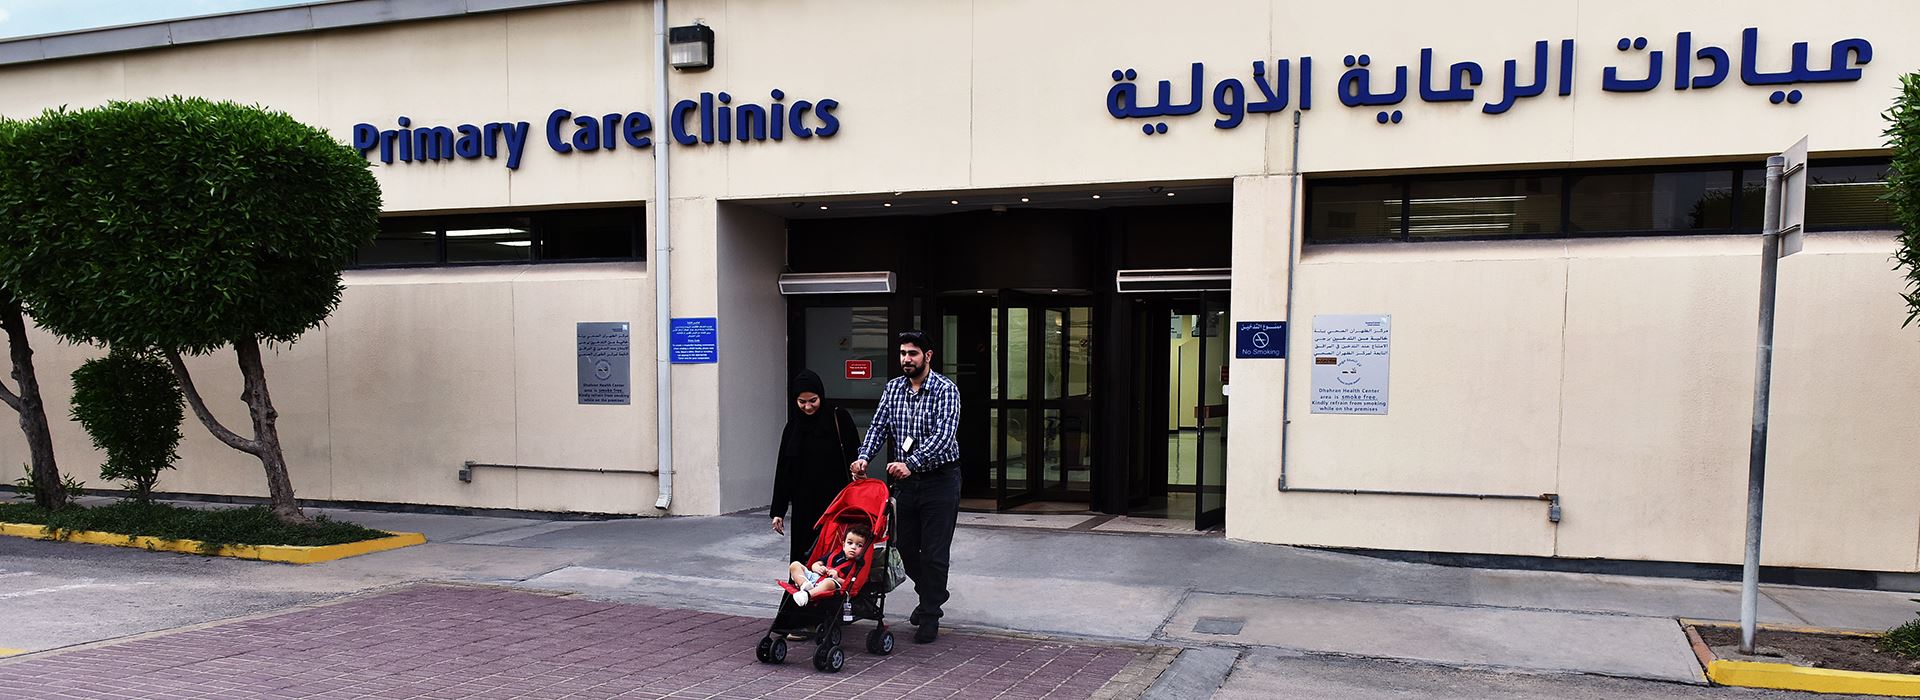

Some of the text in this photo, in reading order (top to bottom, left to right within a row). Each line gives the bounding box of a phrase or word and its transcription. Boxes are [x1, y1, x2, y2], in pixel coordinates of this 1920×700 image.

[1106, 27, 1873, 135] عيادات الرعاية الأولية
[353, 89, 840, 170] Primary Care Clinics
[1252, 348, 1280, 356] Smoking
